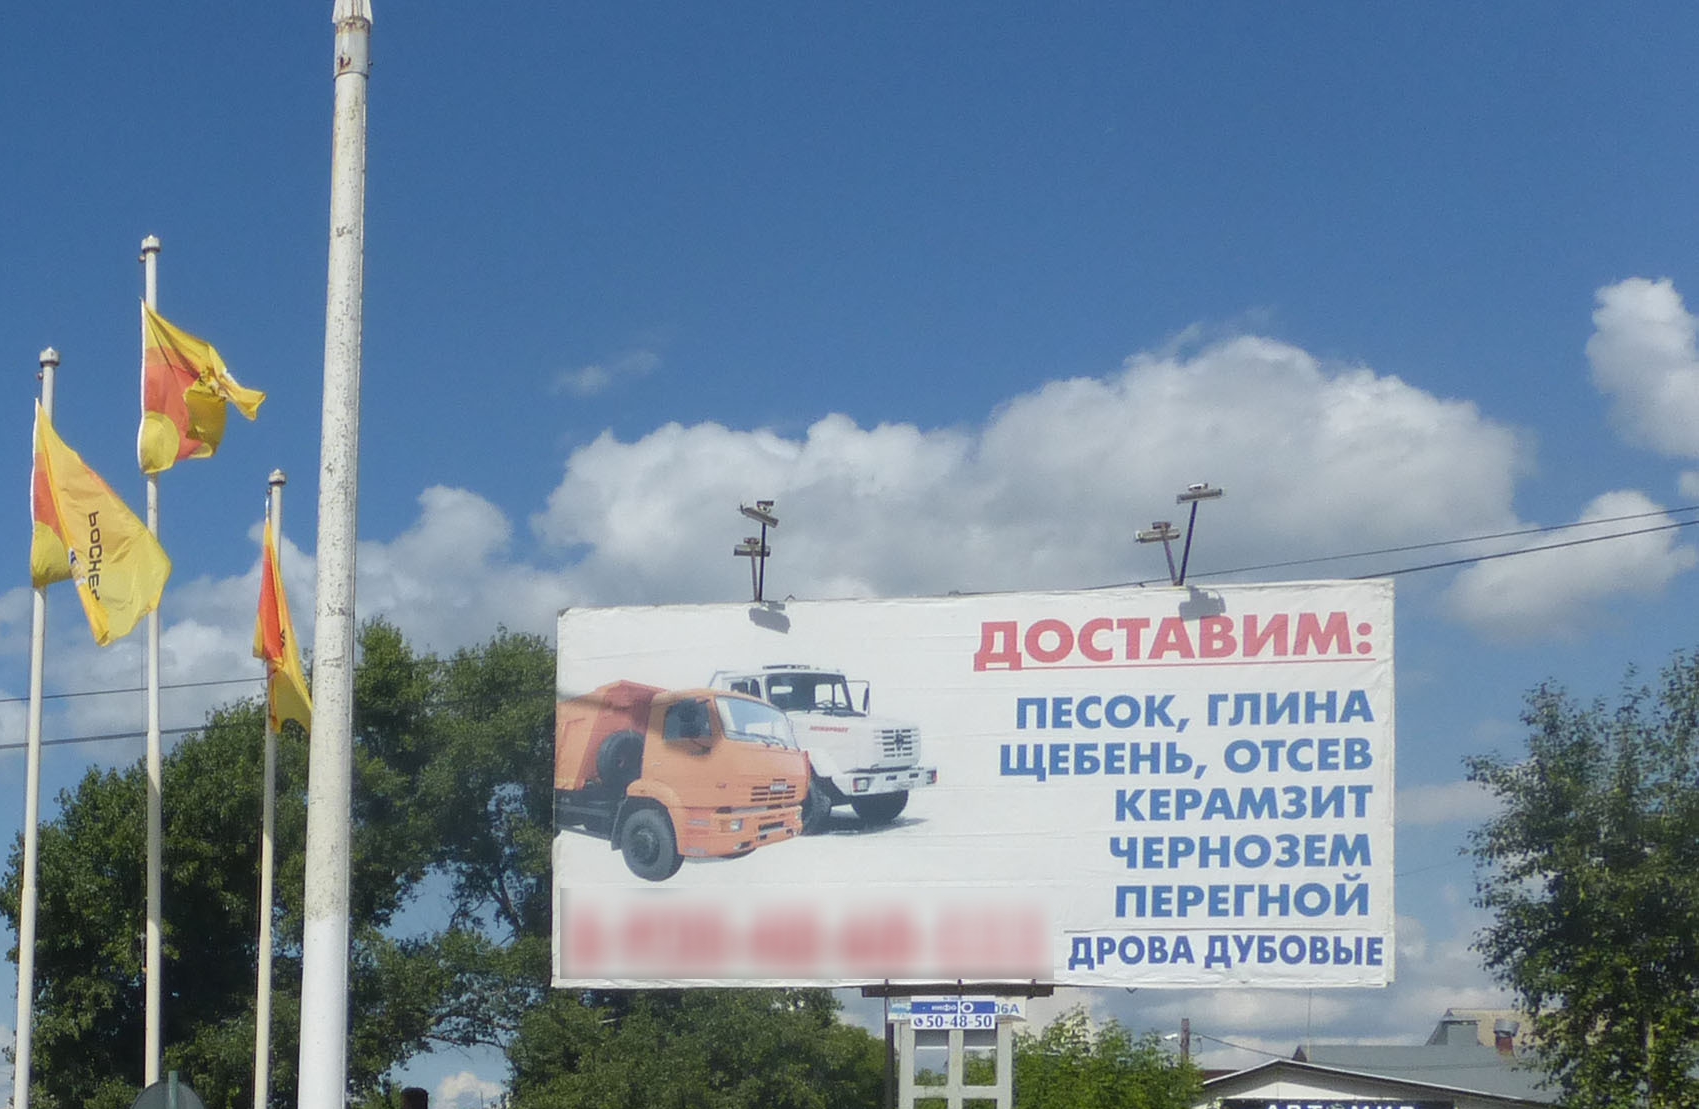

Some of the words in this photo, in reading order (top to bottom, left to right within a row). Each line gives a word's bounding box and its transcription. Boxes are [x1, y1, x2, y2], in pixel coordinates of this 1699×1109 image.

[973, 611, 1373, 672] ДОСТАВИМ:
[1015, 694, 1191, 733] ПЕСОК,
[1206, 689, 1375, 726] ГЛИНА
[999, 741, 1208, 782] ЩЕБЕНЬ,
[1223, 737, 1374, 774] ОТСЕВ
[1114, 784, 1374, 822] КЕРАМЗИТ
[1108, 833, 1372, 869] ЧЕРНОЗЕМ
[1114, 872, 1370, 918] ПЕРЕГНОЙ
[1067, 935, 1195, 971] ДРОВА
[1203, 934, 1384, 969] ДУБОВЫЕ
[926, 1014, 993, 1028] 50-48-50
